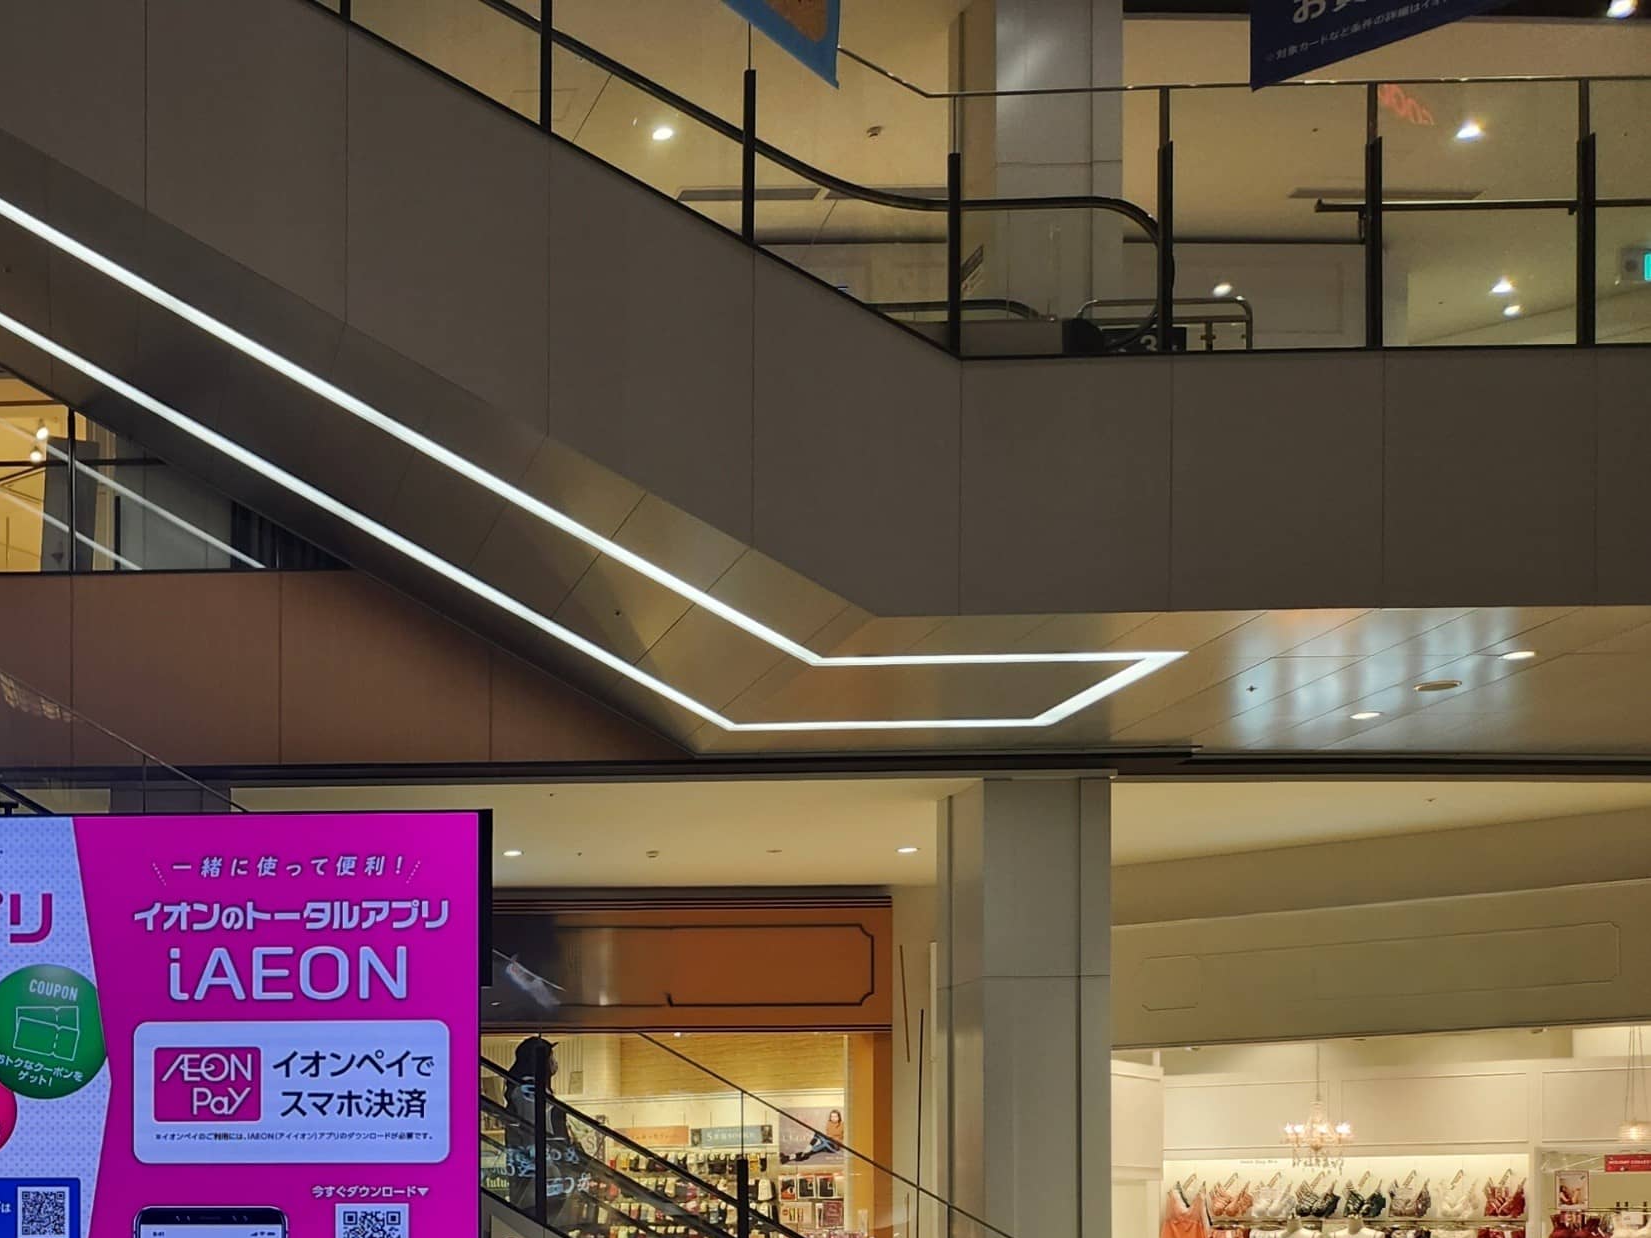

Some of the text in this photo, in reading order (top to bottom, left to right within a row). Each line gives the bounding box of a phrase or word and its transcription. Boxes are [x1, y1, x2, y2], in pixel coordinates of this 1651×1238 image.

[172, 856, 404, 877] 一緒に使って便利！
[134, 900, 449, 931] イオンのトータルアプリ
[168, 946, 408, 1001] iAEON
[29, 978, 78, 1001] COUPON
[272, 1050, 435, 1078] イオンペイで
[280, 1088, 427, 1119] スマホ決済
[312, 1185, 416, 1198] 今すぐダウンロード
